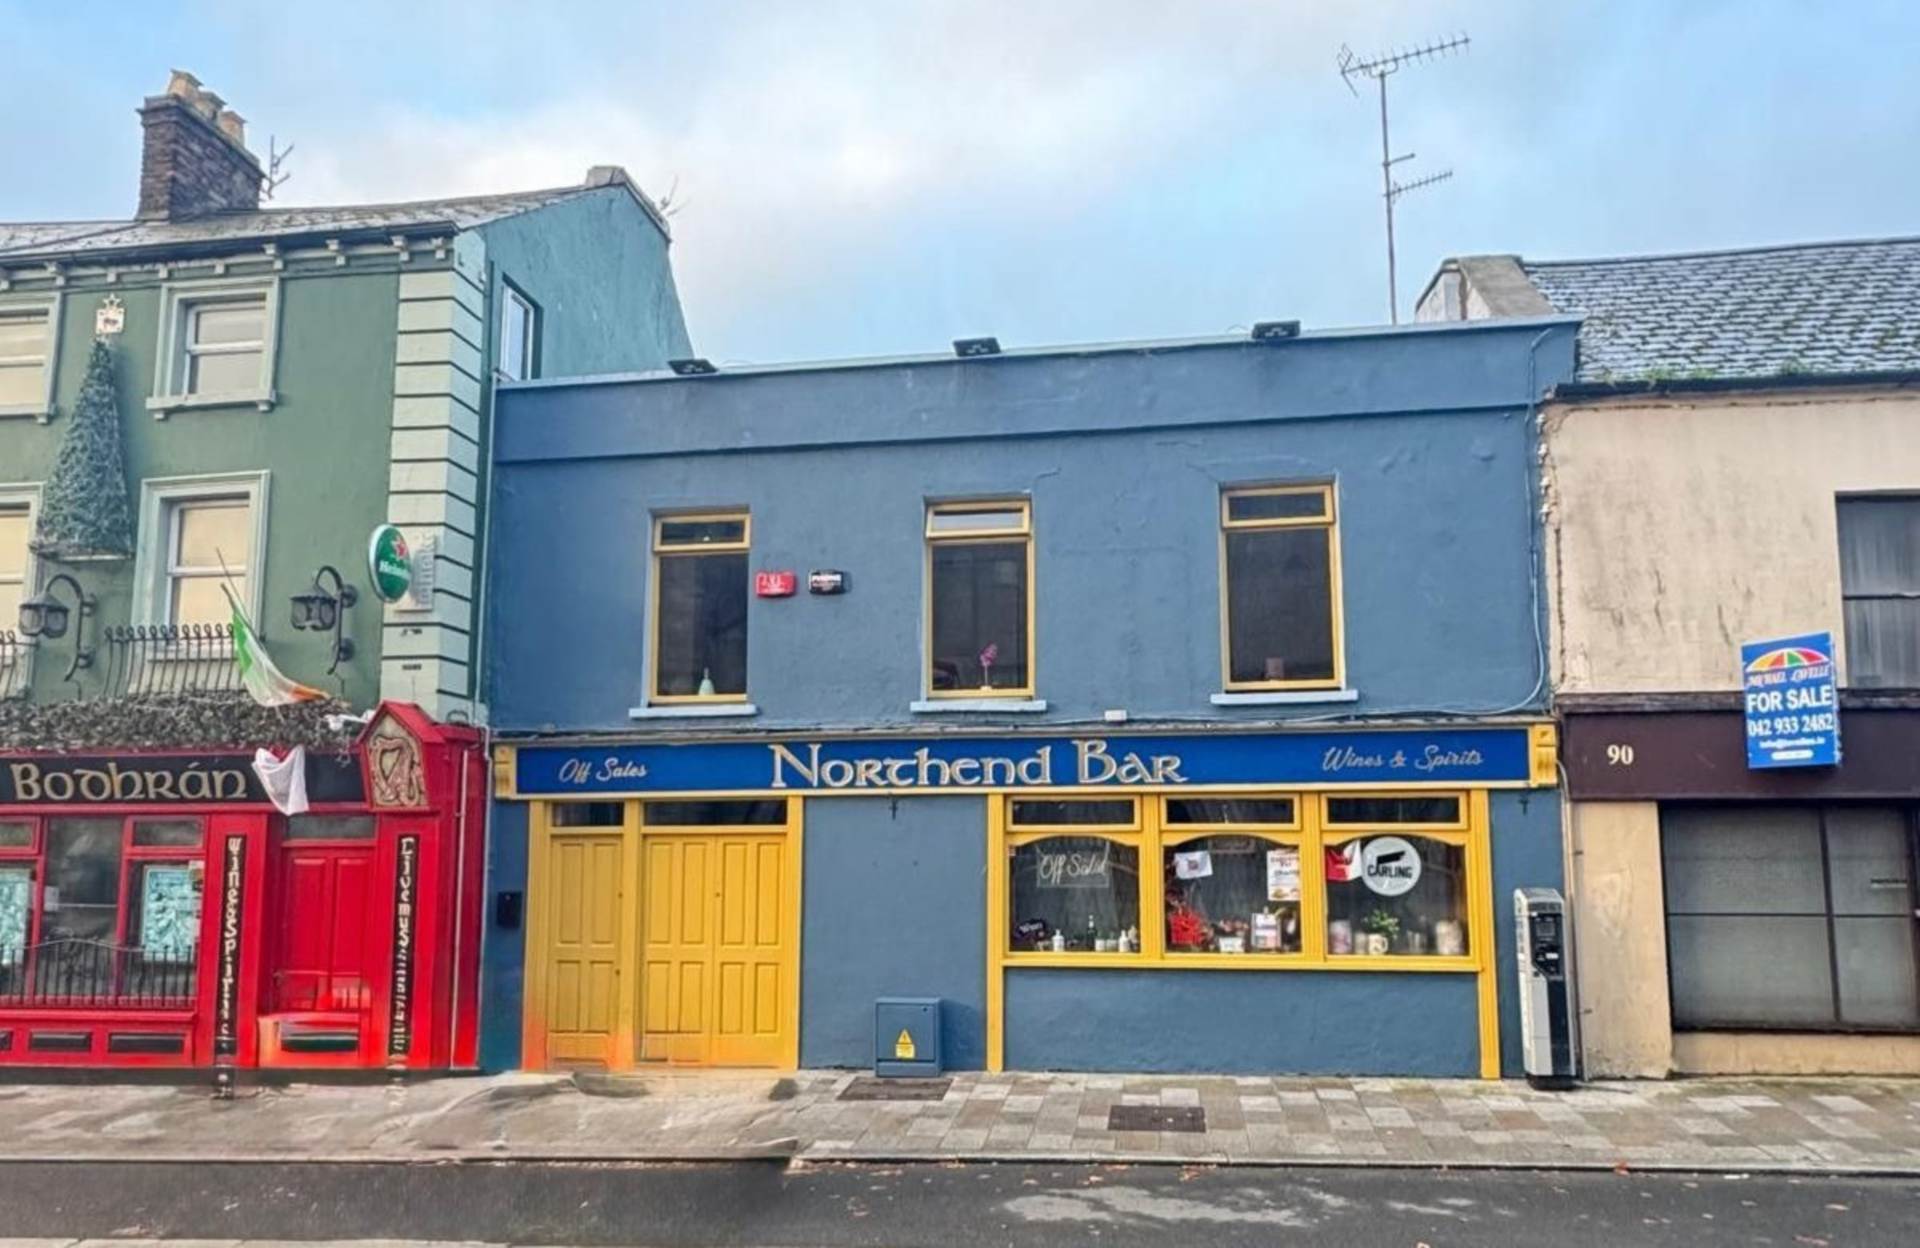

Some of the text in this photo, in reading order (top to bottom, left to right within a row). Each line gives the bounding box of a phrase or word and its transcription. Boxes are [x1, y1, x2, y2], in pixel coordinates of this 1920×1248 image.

[379, 560, 410, 581] Heine
[1747, 685, 1832, 713] FOR SALE
[1748, 712, 1833, 737] 042 933 2482
[767, 743, 1052, 788] Northend
[1322, 744, 1484, 772] Wines & Spirits
[1607, 744, 1634, 765] 90
[558, 757, 647, 784] Off Sales
[1367, 864, 1413, 878] CARLING
